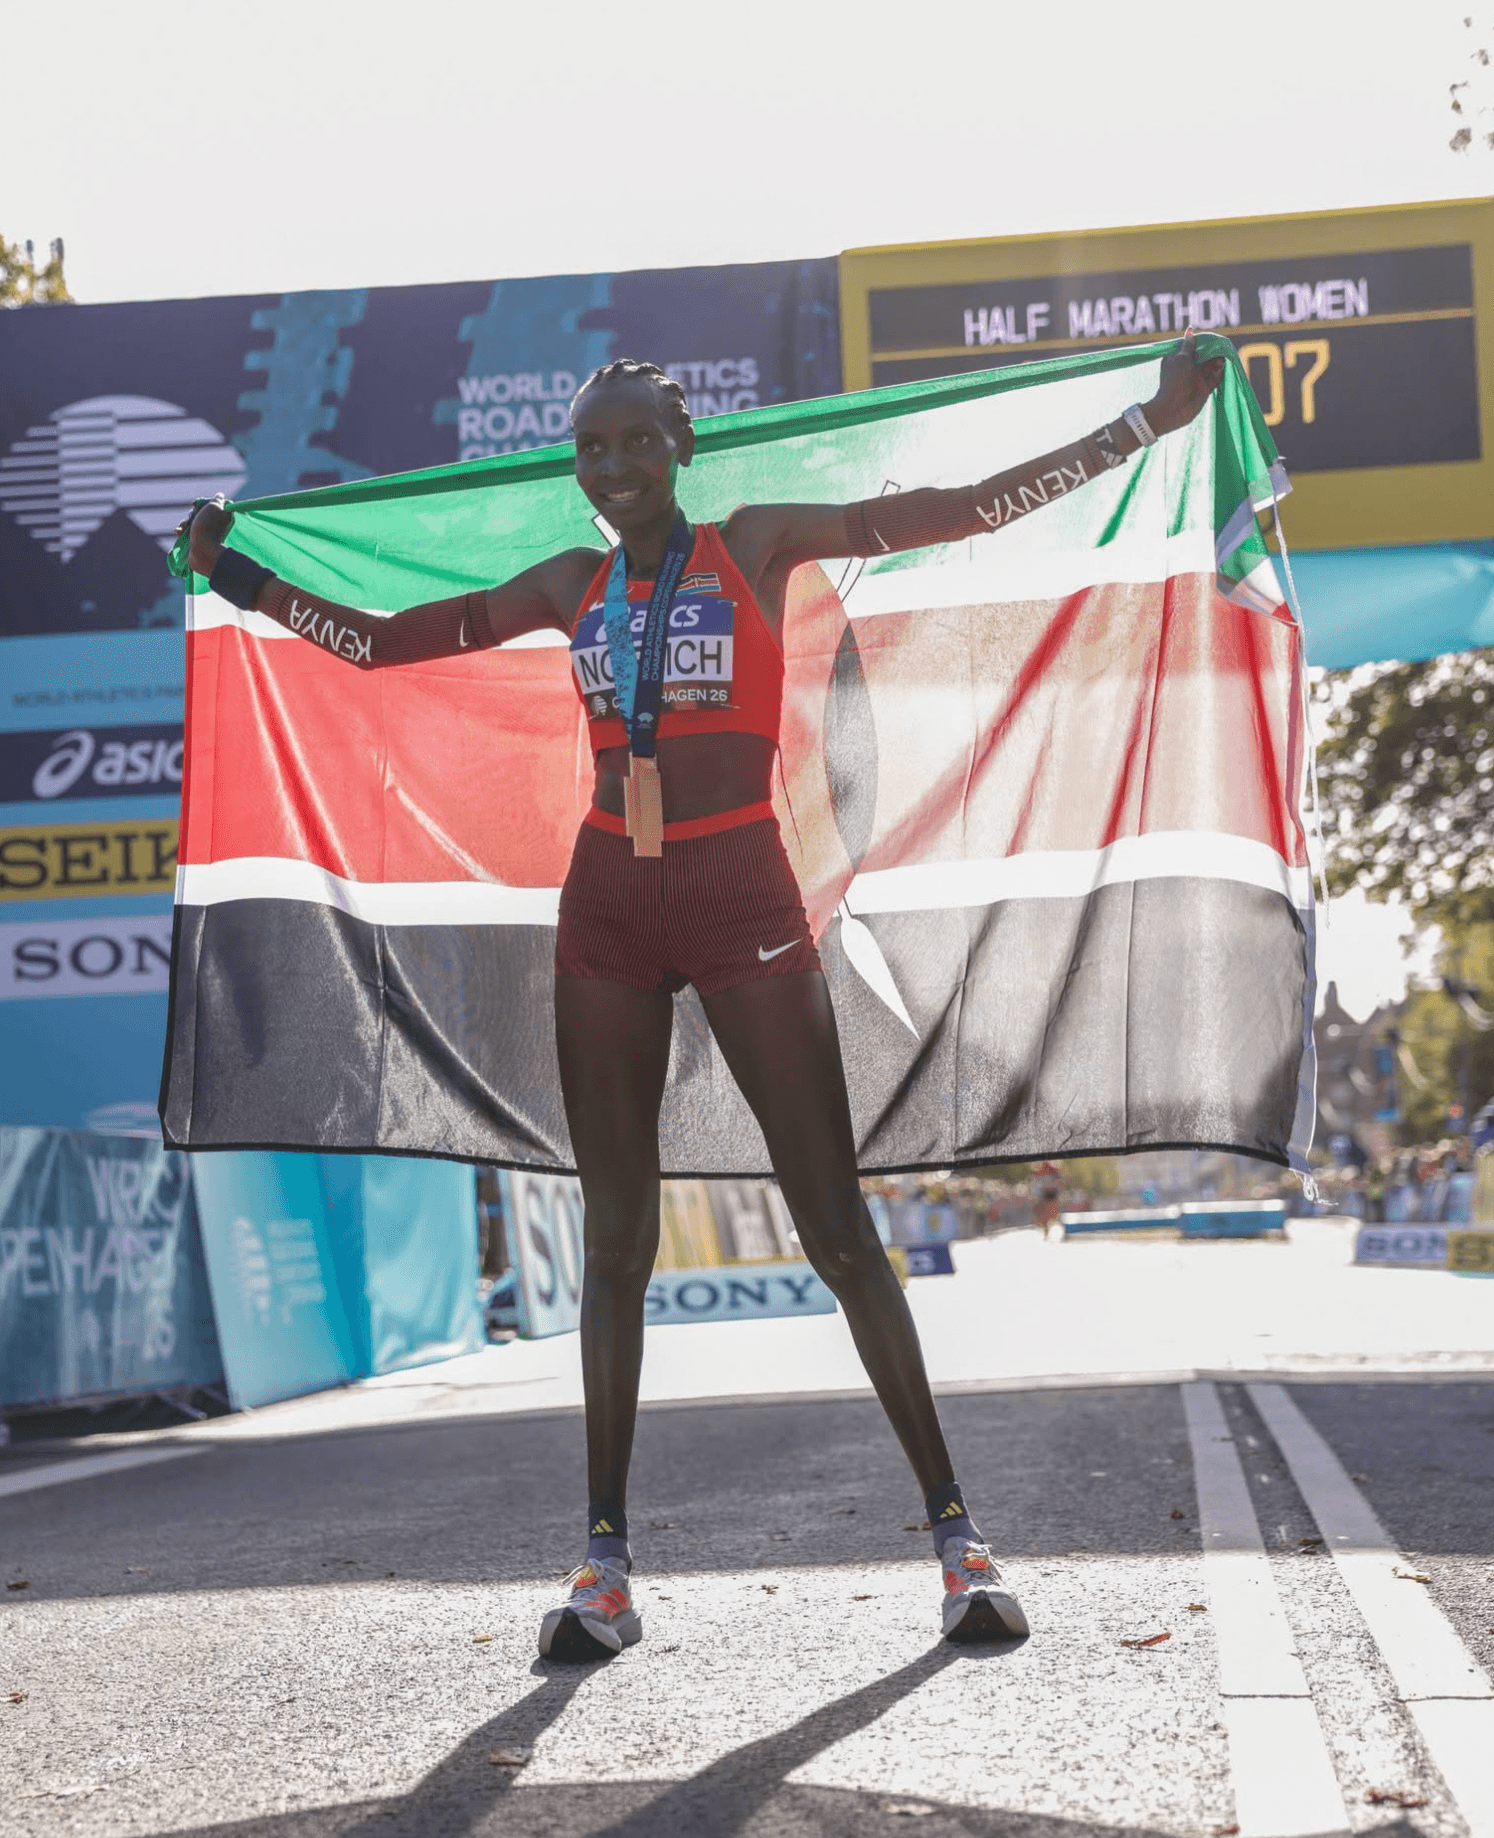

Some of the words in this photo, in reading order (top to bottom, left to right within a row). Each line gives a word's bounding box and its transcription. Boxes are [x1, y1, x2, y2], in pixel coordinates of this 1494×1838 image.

[964, 303, 1050, 346] HALF
[1068, 288, 1240, 338] MARATHON
[1259, 278, 1369, 324] WOMEN
[458, 370, 577, 405] WORLD
[458, 403, 570, 441] ROAD
[976, 460, 1088, 527] KENYA
[289, 599, 372, 662] KENYA
[710, 689, 728, 702] 26
[92, 740, 184, 785] asic
[0, 830, 179, 890] SEIK
[13, 934, 171, 983] SON
[644, 1276, 816, 1314] SONY
